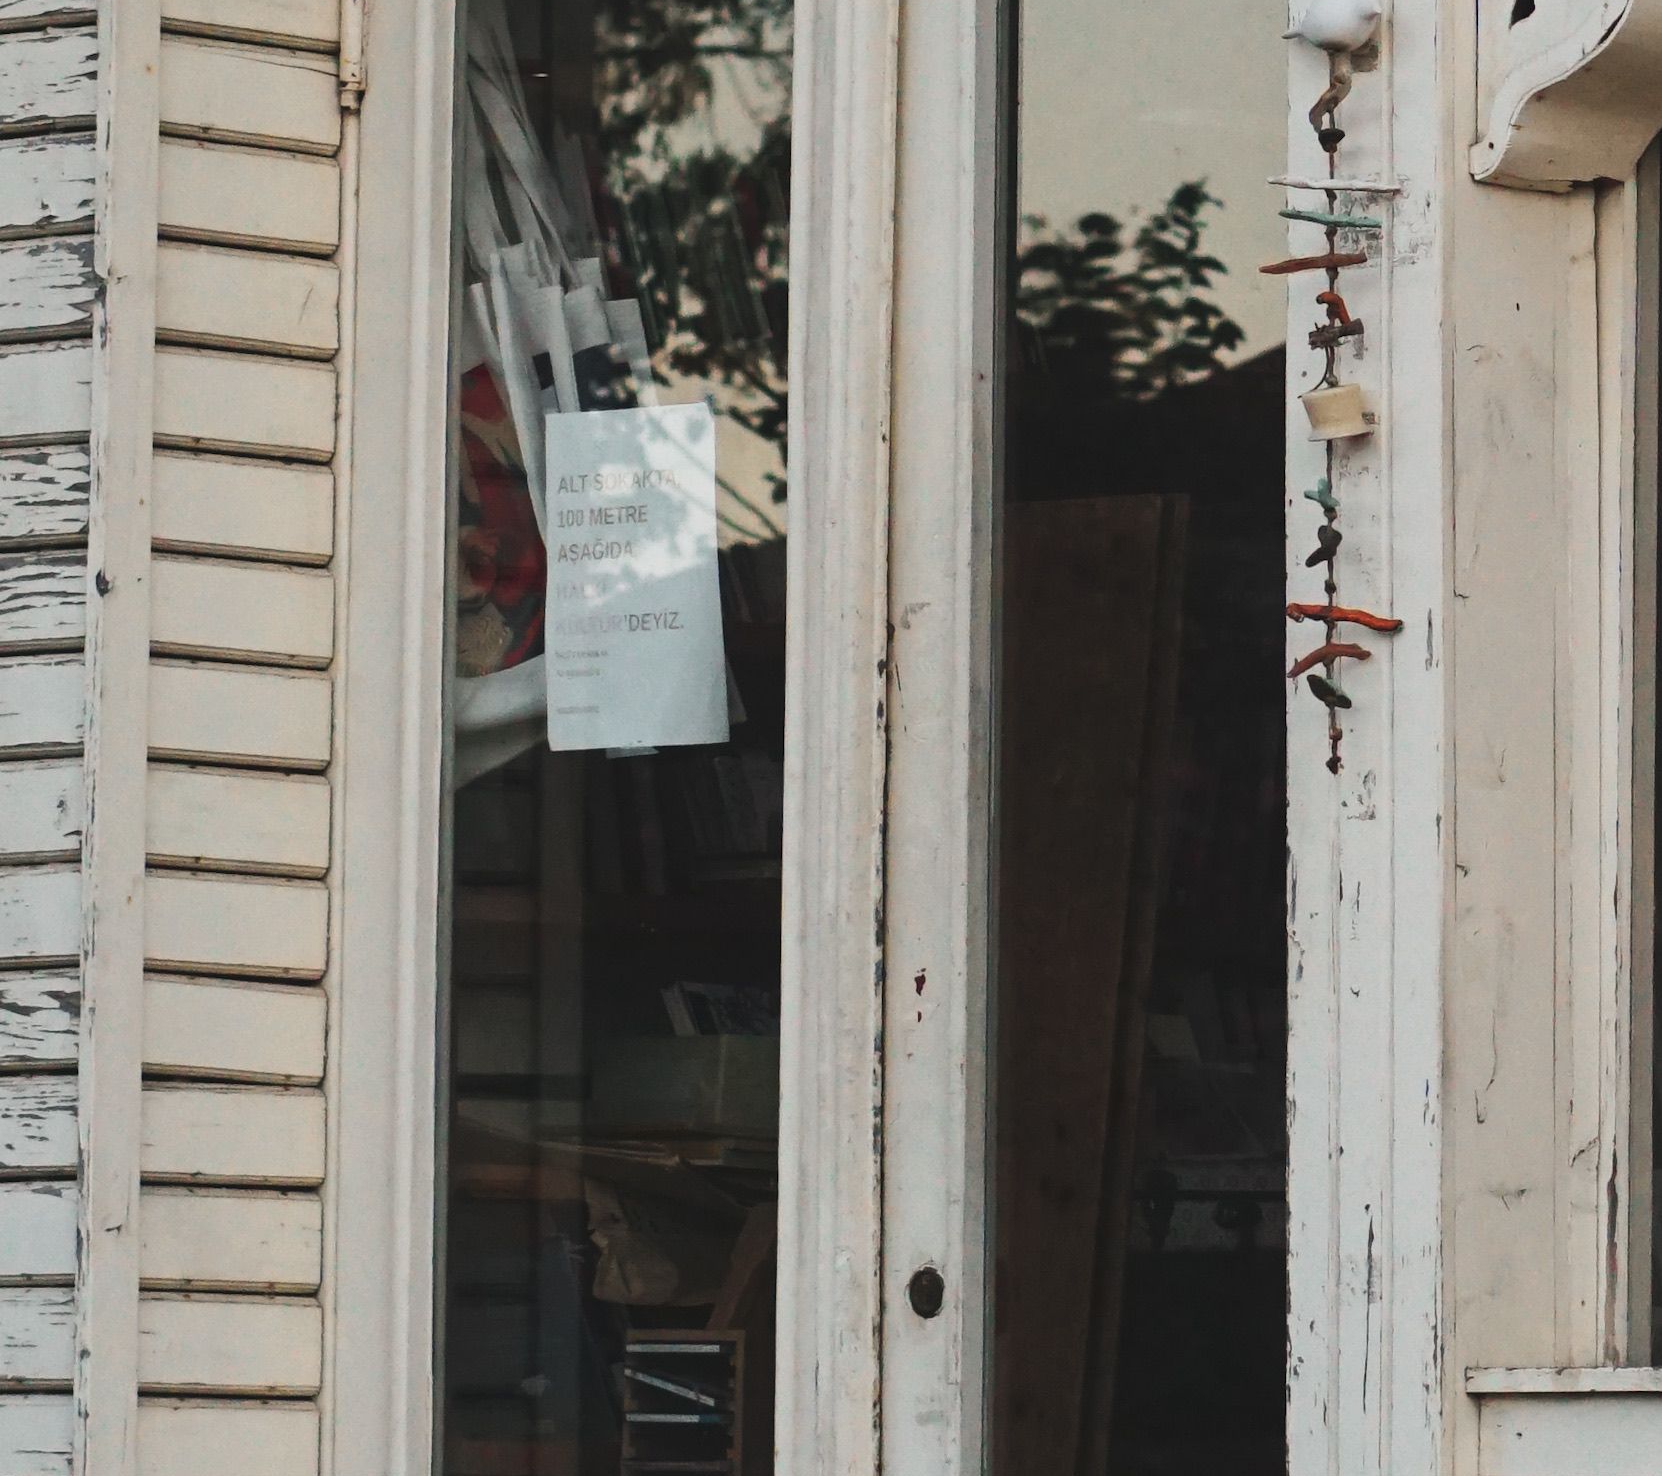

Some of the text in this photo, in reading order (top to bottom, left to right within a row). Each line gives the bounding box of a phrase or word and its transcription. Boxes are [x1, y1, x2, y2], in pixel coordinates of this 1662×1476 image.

[557, 473, 589, 494] ALT
[557, 504, 648, 528] 100 METRE
[557, 538, 633, 565] AŞAĞIDA
